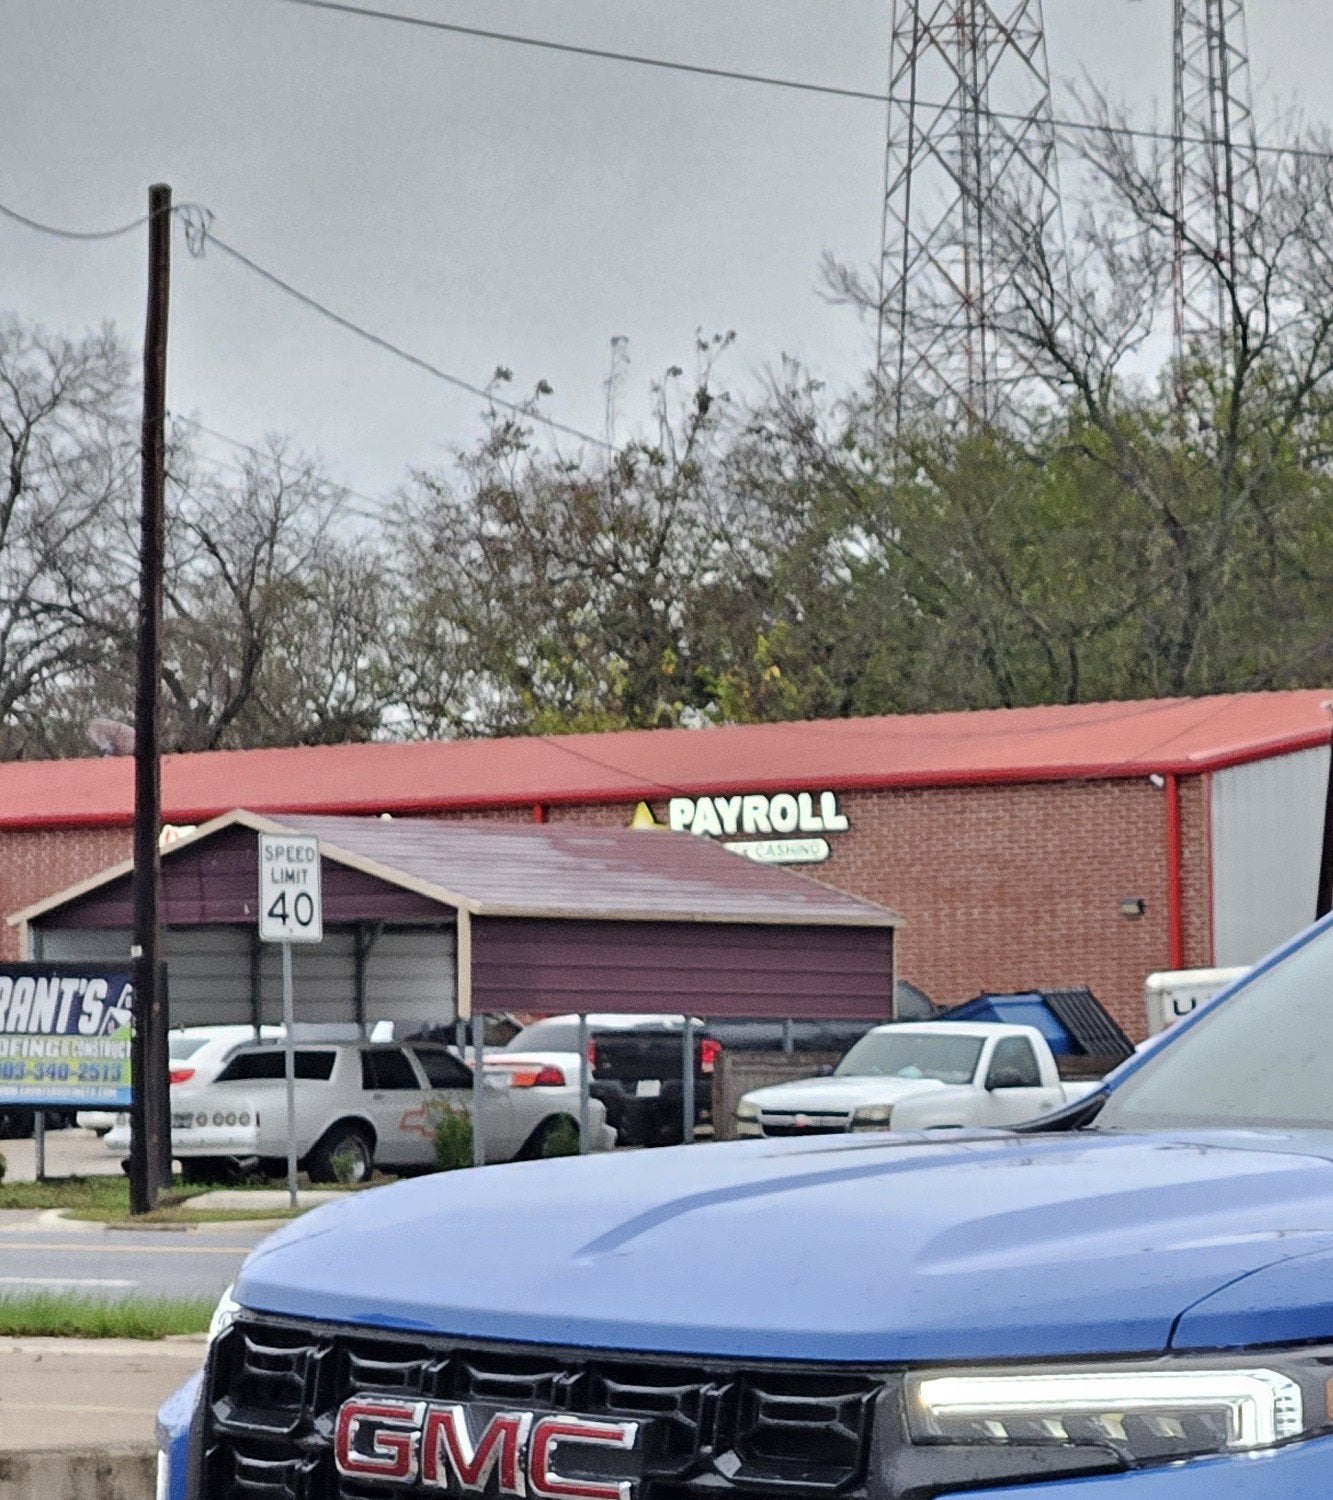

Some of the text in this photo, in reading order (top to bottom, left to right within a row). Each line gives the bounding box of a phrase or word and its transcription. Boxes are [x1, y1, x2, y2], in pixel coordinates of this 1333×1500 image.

[669, 791, 849, 836] PAYROLL
[264, 844, 316, 863] SPEED
[270, 866, 308, 885] LIMIT
[267, 890, 314, 927] 40
